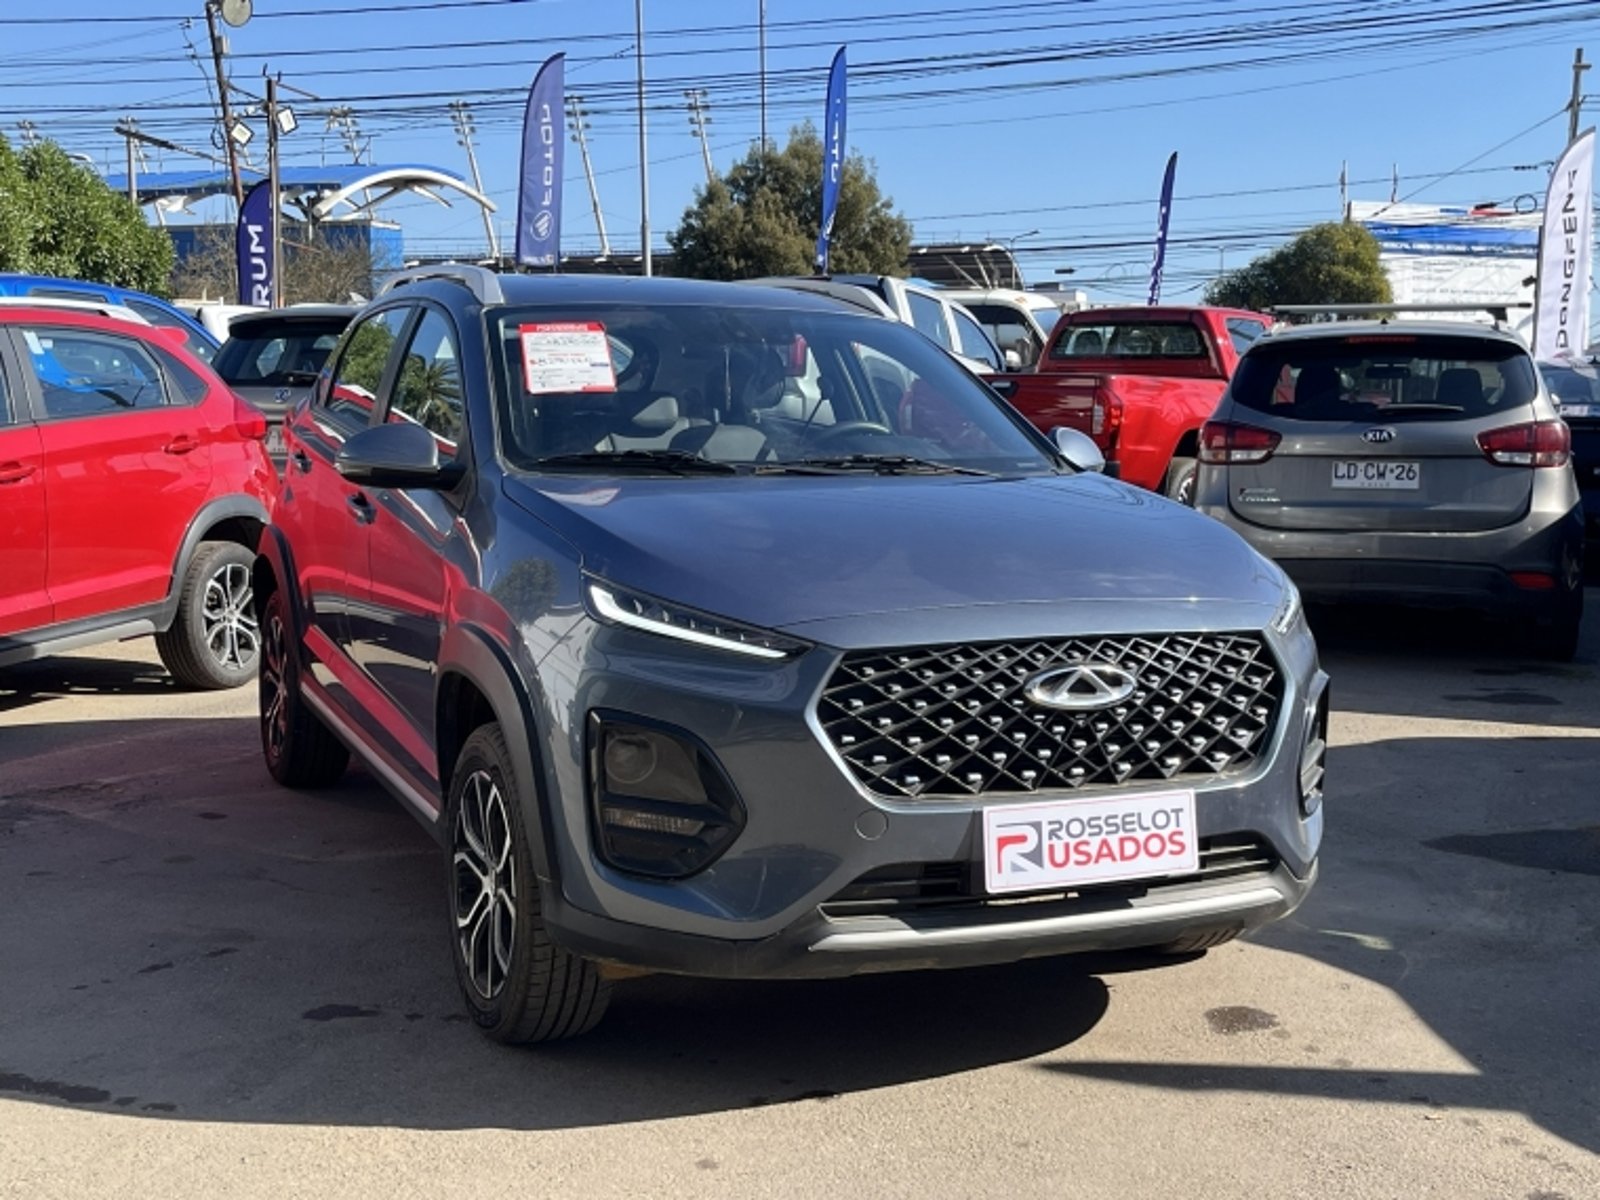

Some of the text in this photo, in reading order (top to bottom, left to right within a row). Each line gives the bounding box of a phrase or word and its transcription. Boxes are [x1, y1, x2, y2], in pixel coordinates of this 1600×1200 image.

[1367, 431, 1389, 441] KIA
[1047, 808, 1184, 841] ROSSELOT
[1048, 831, 1186, 868] USADOS
